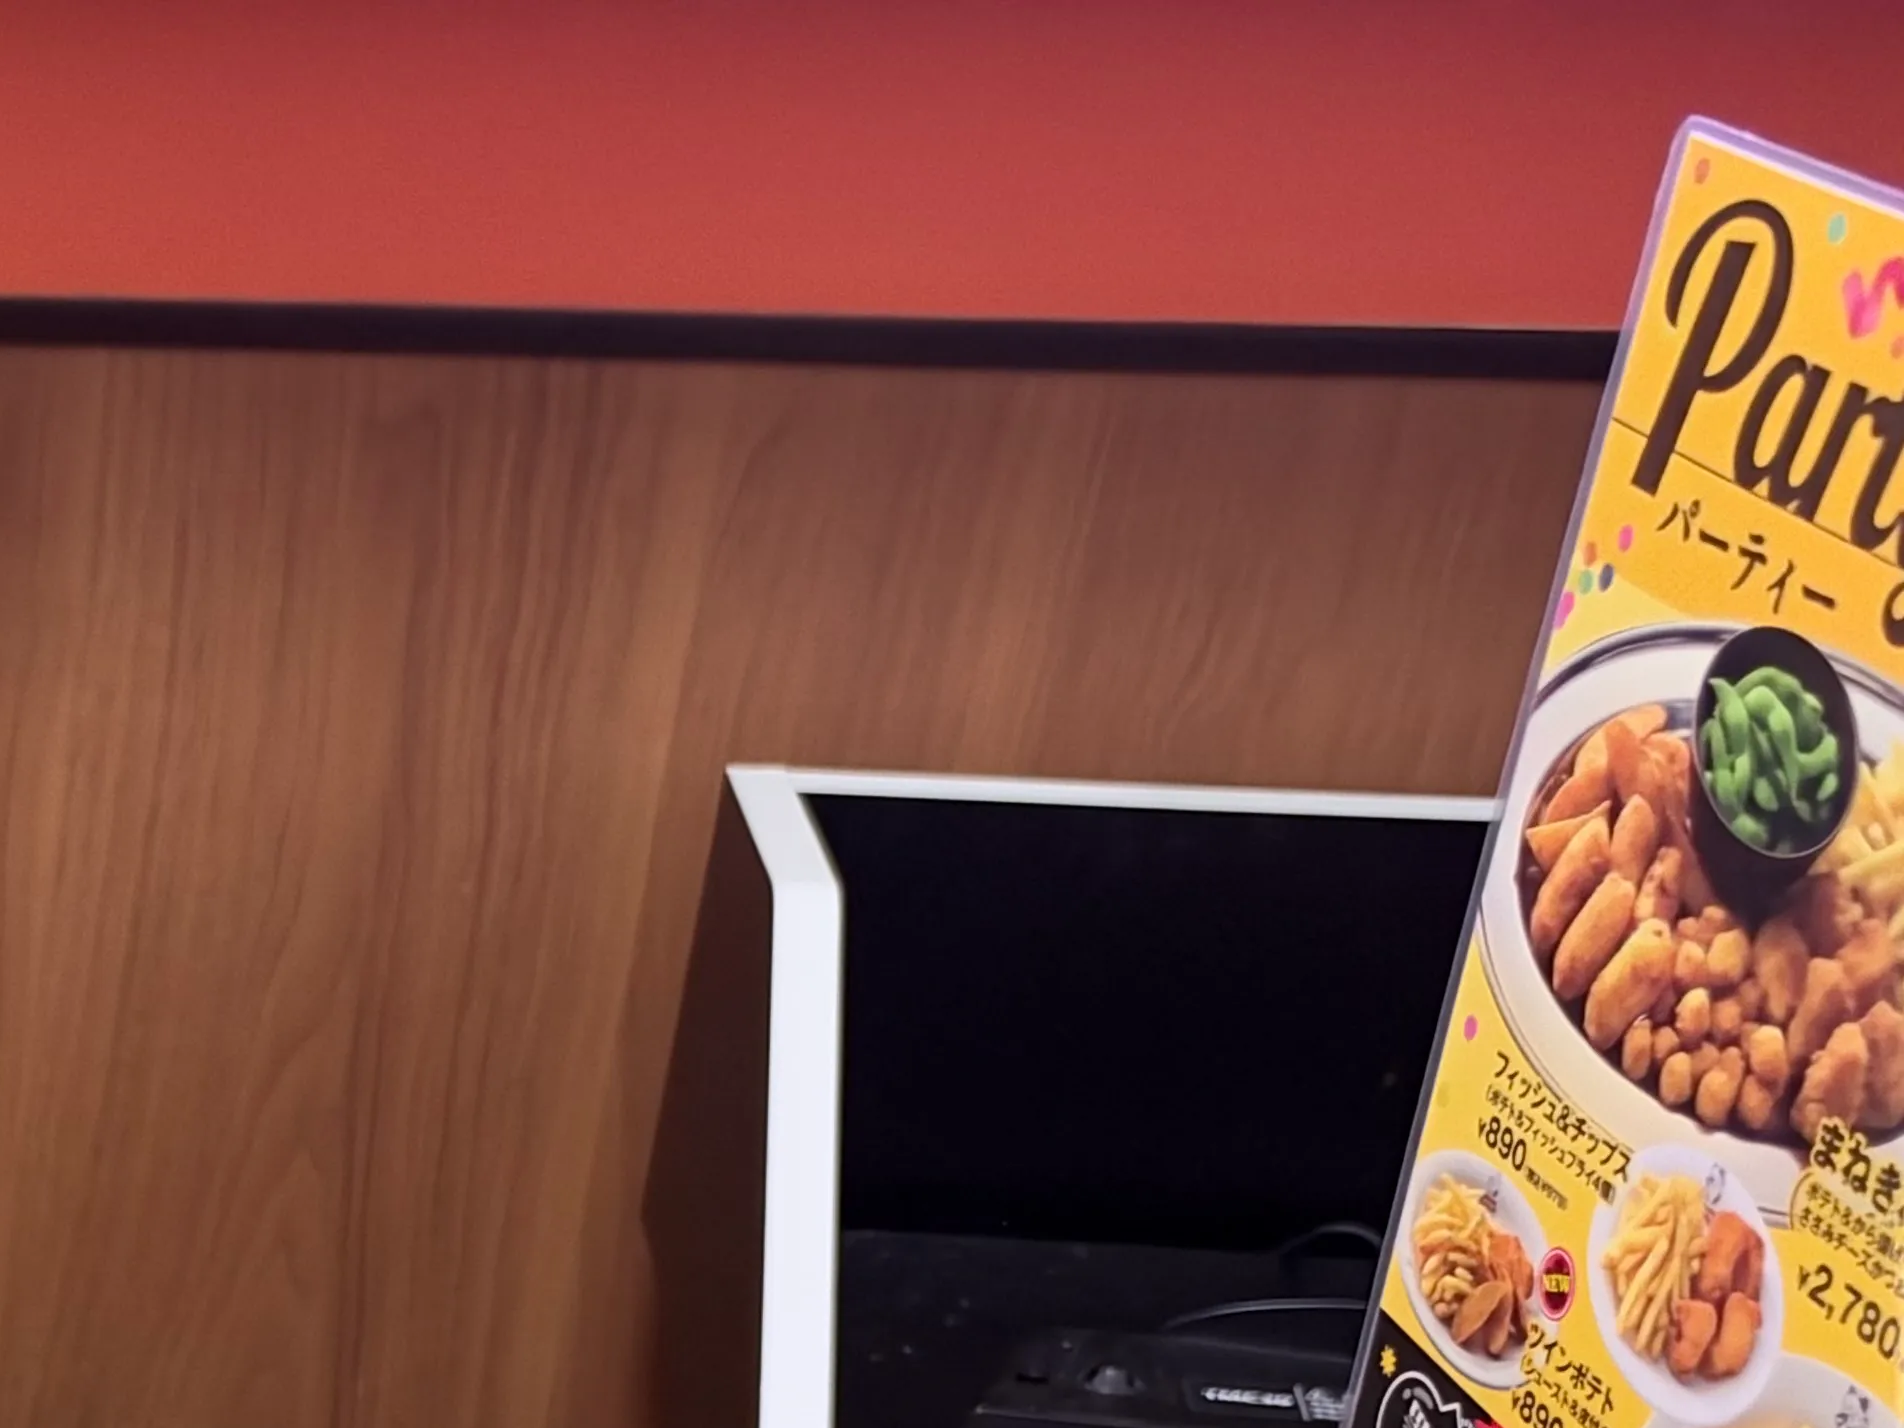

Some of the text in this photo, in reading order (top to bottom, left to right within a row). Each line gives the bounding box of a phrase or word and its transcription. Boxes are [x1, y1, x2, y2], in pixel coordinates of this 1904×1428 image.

[1657, 500, 1836, 613] パーティー
[1479, 1116, 1527, 1172] ¥890
[1798, 1264, 1901, 1360] ¥2,780
